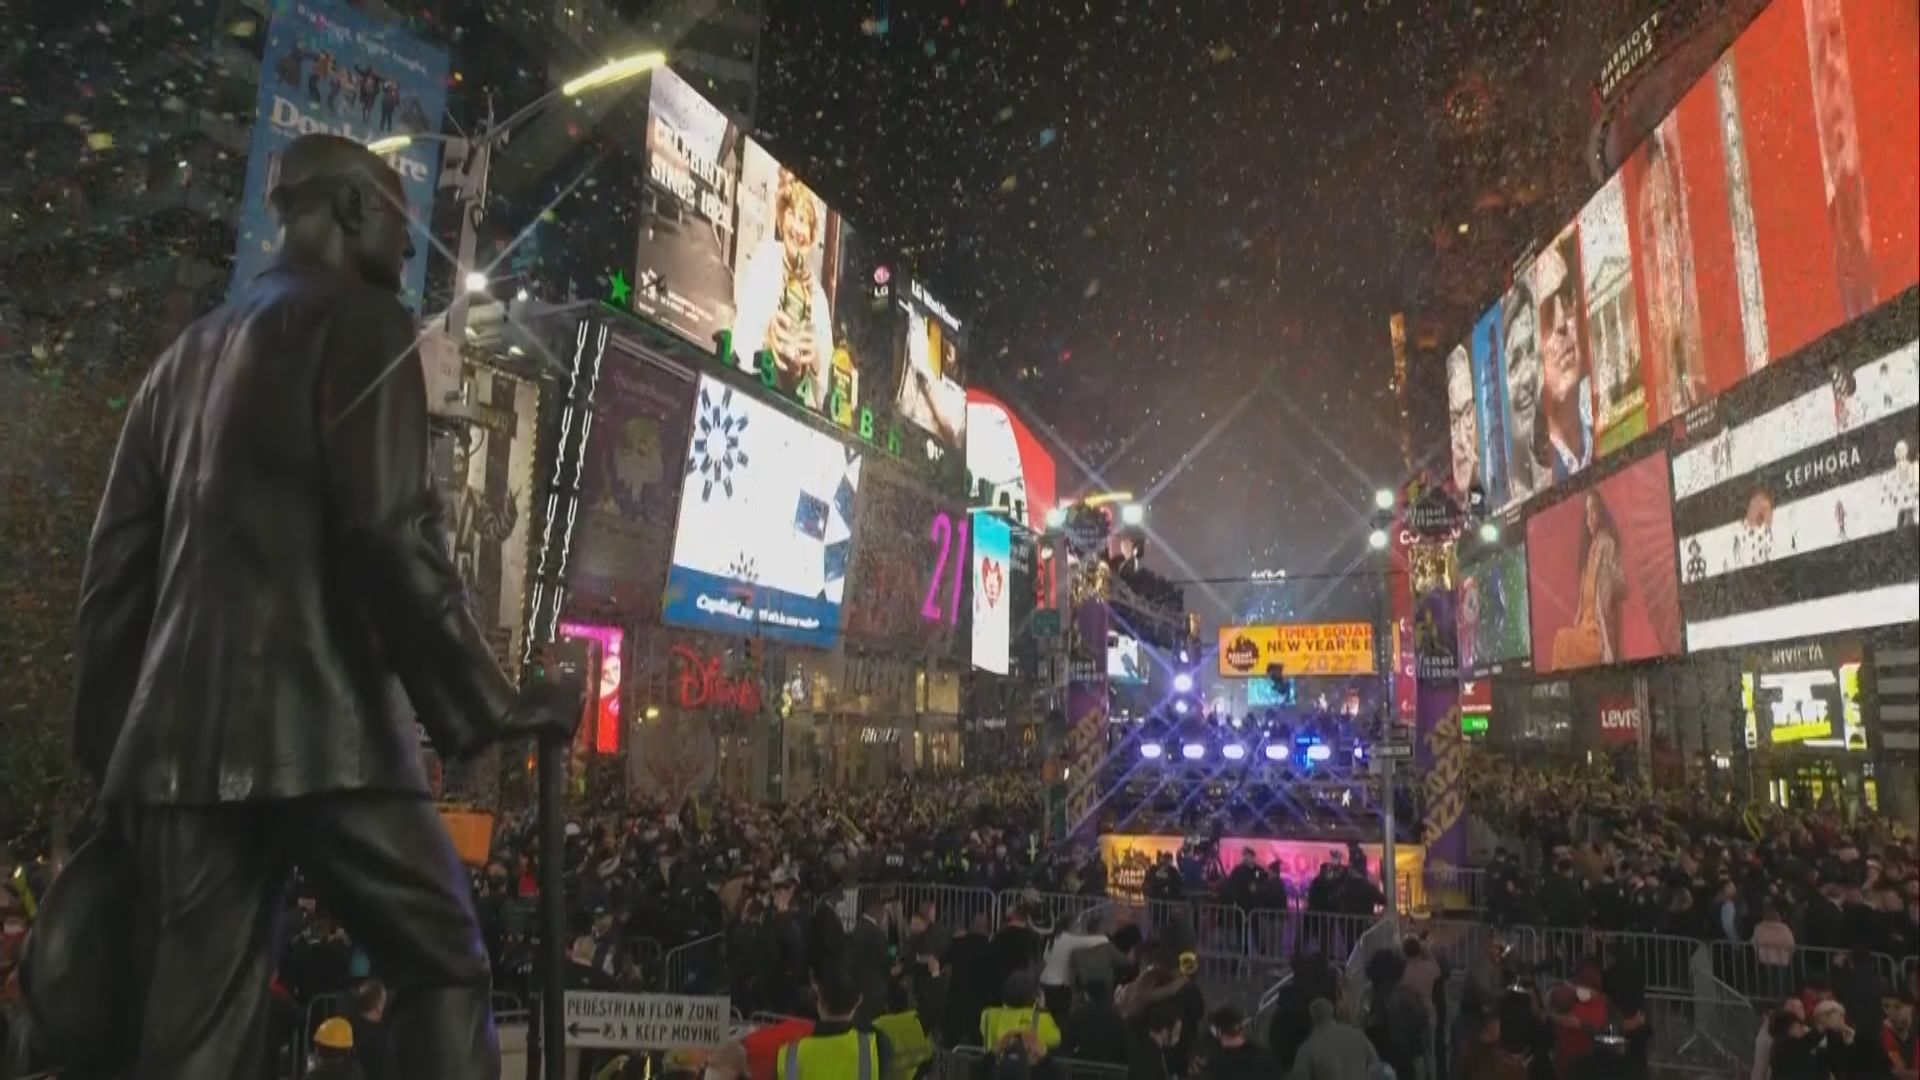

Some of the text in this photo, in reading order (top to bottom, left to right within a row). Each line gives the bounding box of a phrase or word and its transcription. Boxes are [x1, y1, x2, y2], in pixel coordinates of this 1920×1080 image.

[1601, 12, 1659, 82] MARRIOTT
[1602, 38, 1653, 99] MARQUIS
[874, 286, 889, 297] LG
[912, 279, 922, 301] LG
[1784, 447, 1861, 489] SEPHORA
[921, 512, 968, 625] 21
[1277, 627, 1320, 640] TIMES
[1267, 640, 1300, 653] NEW
[1303, 639, 1356, 651] YEAR'S
[1772, 642, 1823, 664] INVICTA
[1303, 654, 1360, 673] 2022
[567, 1000, 721, 1021] PEDESTRIAN FLOW ZONE
[635, 1023, 721, 1042] KEEP MOVING
